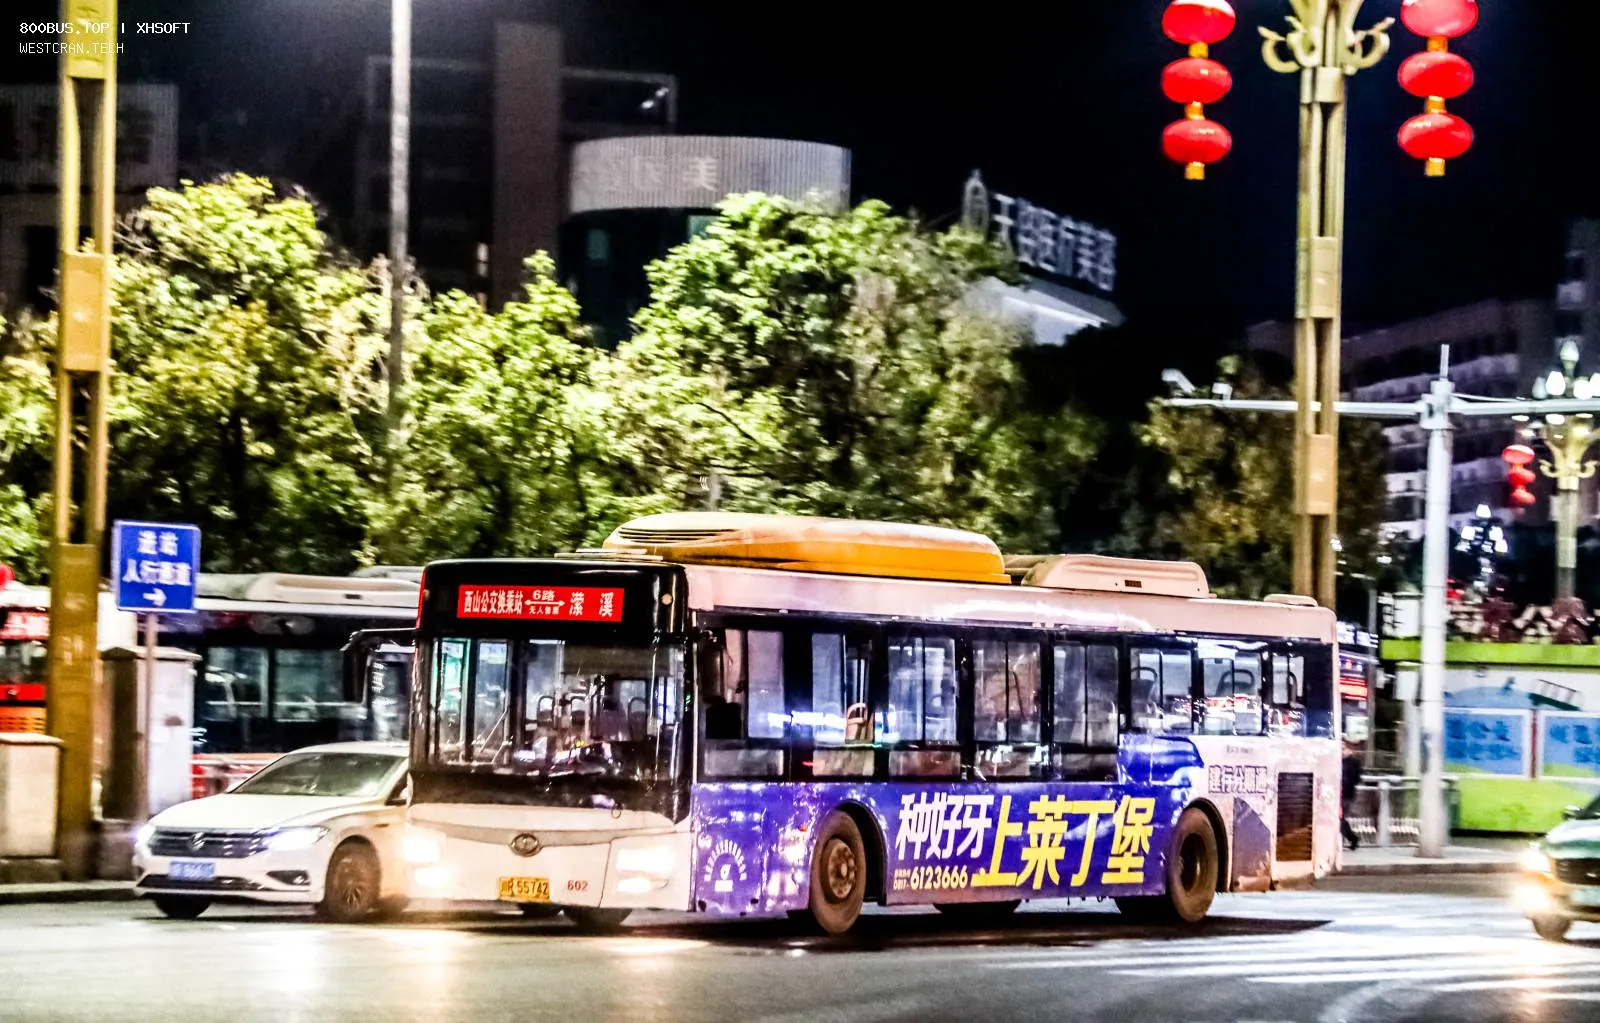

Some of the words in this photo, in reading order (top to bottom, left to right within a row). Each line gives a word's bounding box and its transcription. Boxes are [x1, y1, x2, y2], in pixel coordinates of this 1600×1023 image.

[464, 590, 523, 614] 西山公交换乘站
[533, 589, 555, 601] 6路
[567, 880, 589, 891] 602
[911, 865, 968, 890] 6123666
